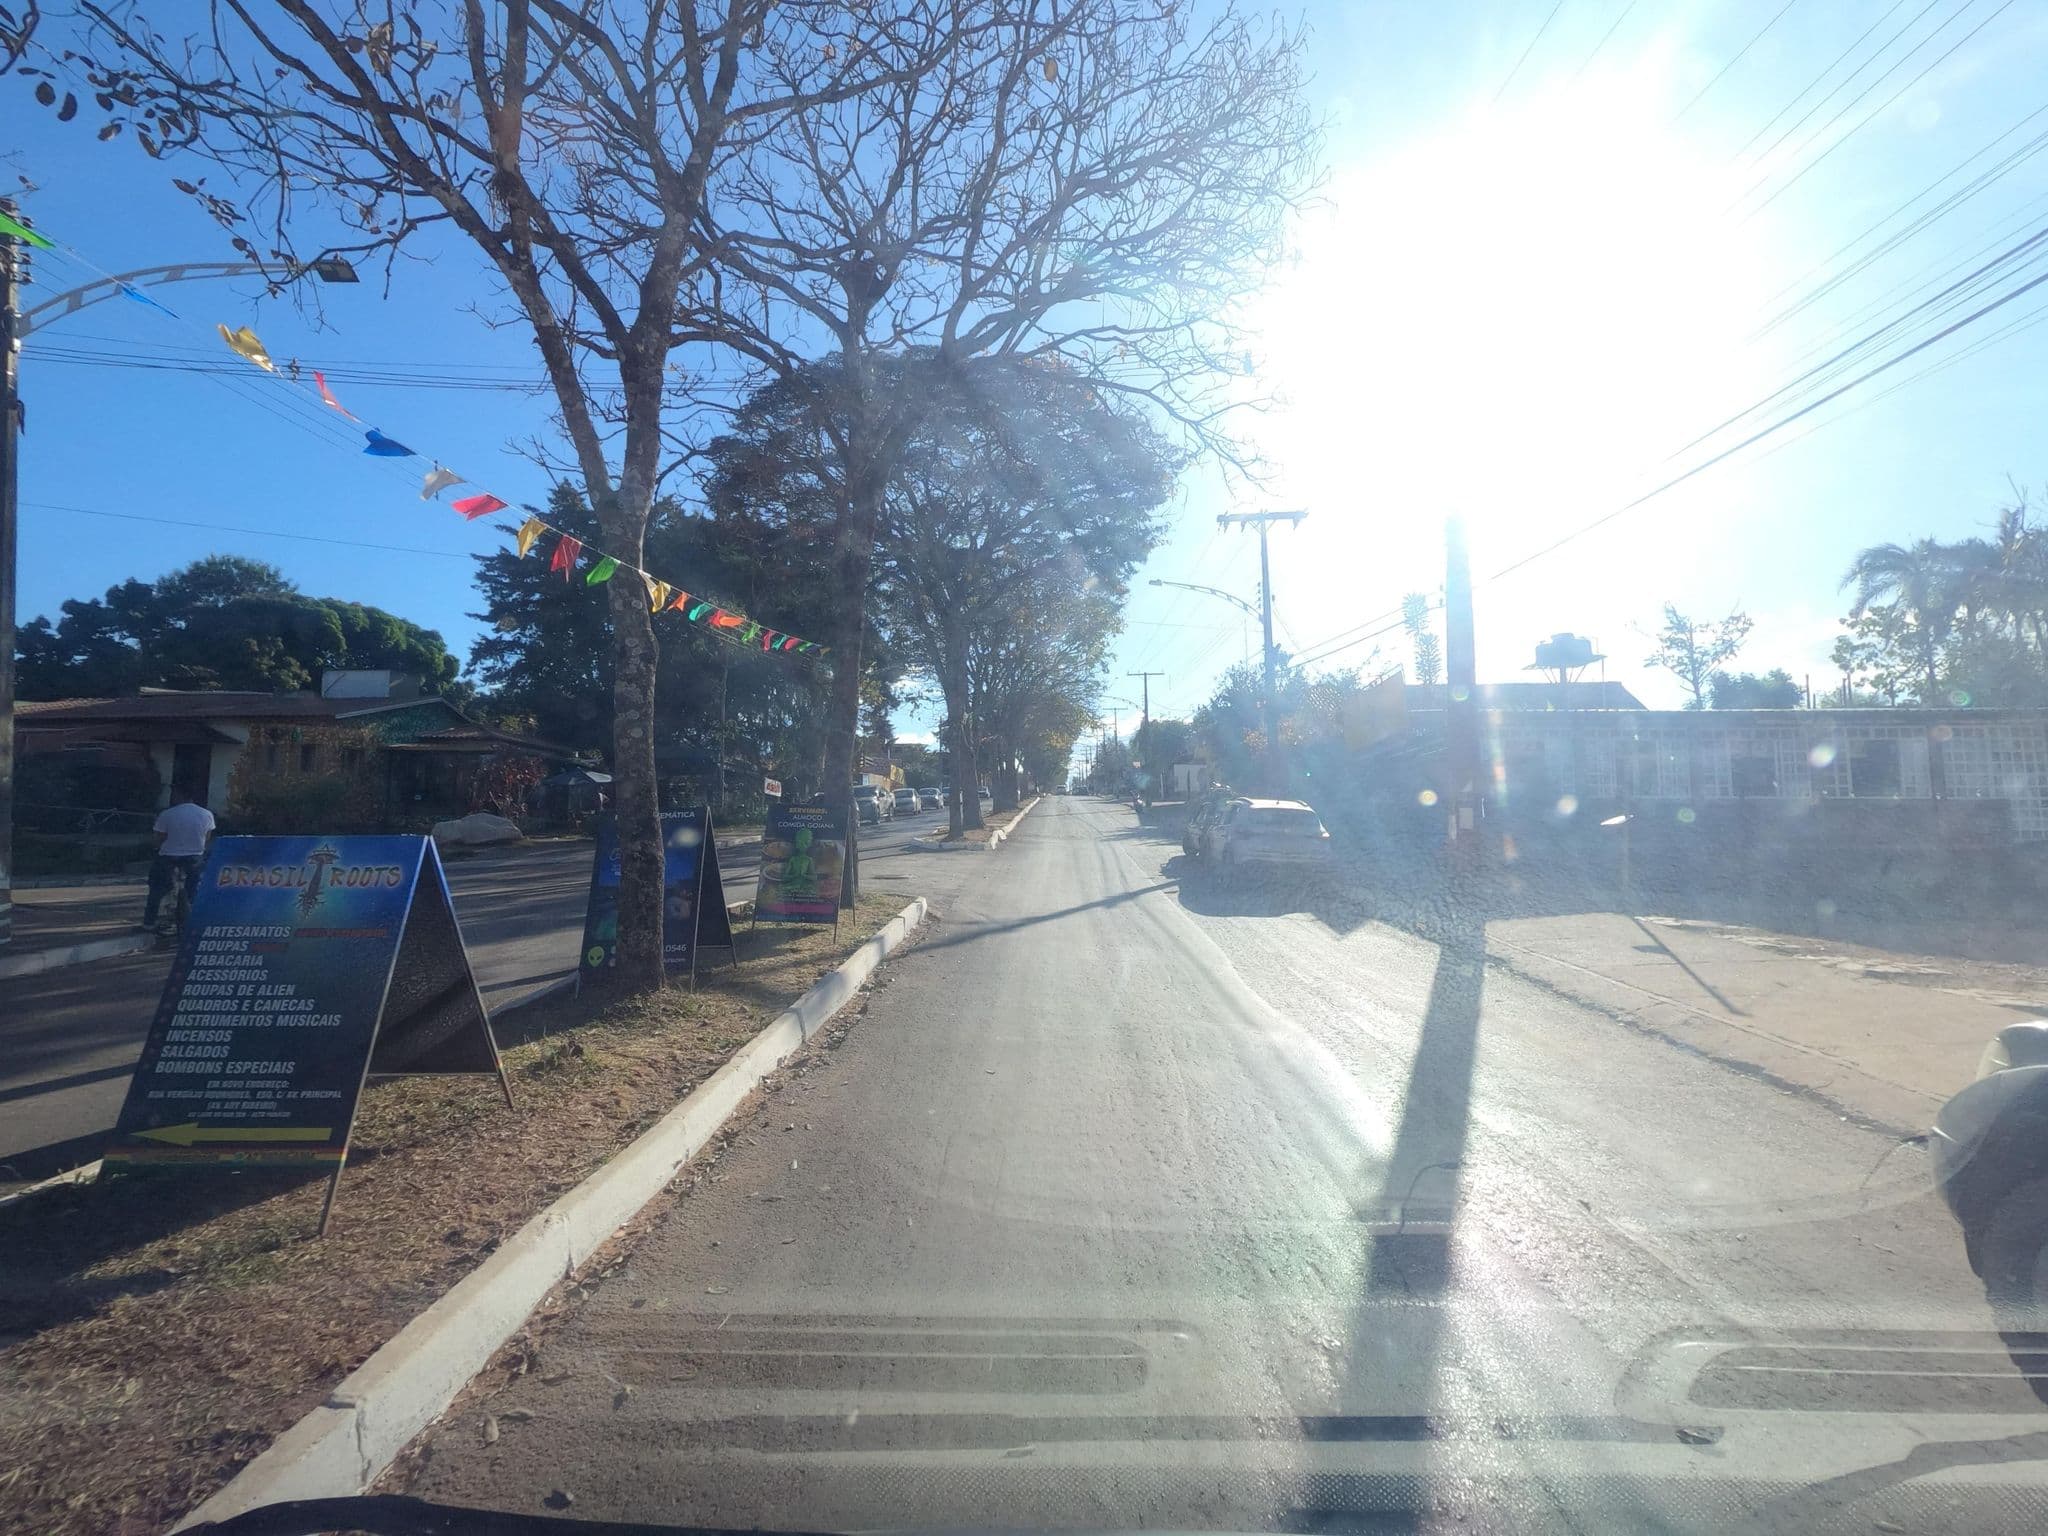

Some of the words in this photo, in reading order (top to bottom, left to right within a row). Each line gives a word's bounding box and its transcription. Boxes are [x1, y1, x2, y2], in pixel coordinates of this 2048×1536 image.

[218, 865, 308, 888] BRASIL
[329, 865, 402, 888] ROOTS
[202, 925, 292, 938] ARTESANATOS
[197, 940, 249, 952] ROUPAS
[193, 954, 264, 967] TABACARIA
[187, 967, 269, 982] ACESSÓRIOS
[182, 984, 235, 996] ROUPAS
[236, 984, 255, 996] DE
[257, 984, 296, 996] ALIEN
[177, 999, 240, 1012] QUADROS
[241, 999, 252, 1012] E
[253, 999, 315, 1012] CANECAS
[171, 1014, 273, 1027] INSTRUMENTOS
[276, 1014, 342, 1027] MUSICAIS
[165, 1029, 233, 1042] INCENSOS
[160, 1045, 231, 1058] SALGADOS
[155, 1061, 224, 1074] BOMBONS
[225, 1061, 296, 1074] ESPECIAIS
[300, 1090, 342, 1099] PRINCIPAL
